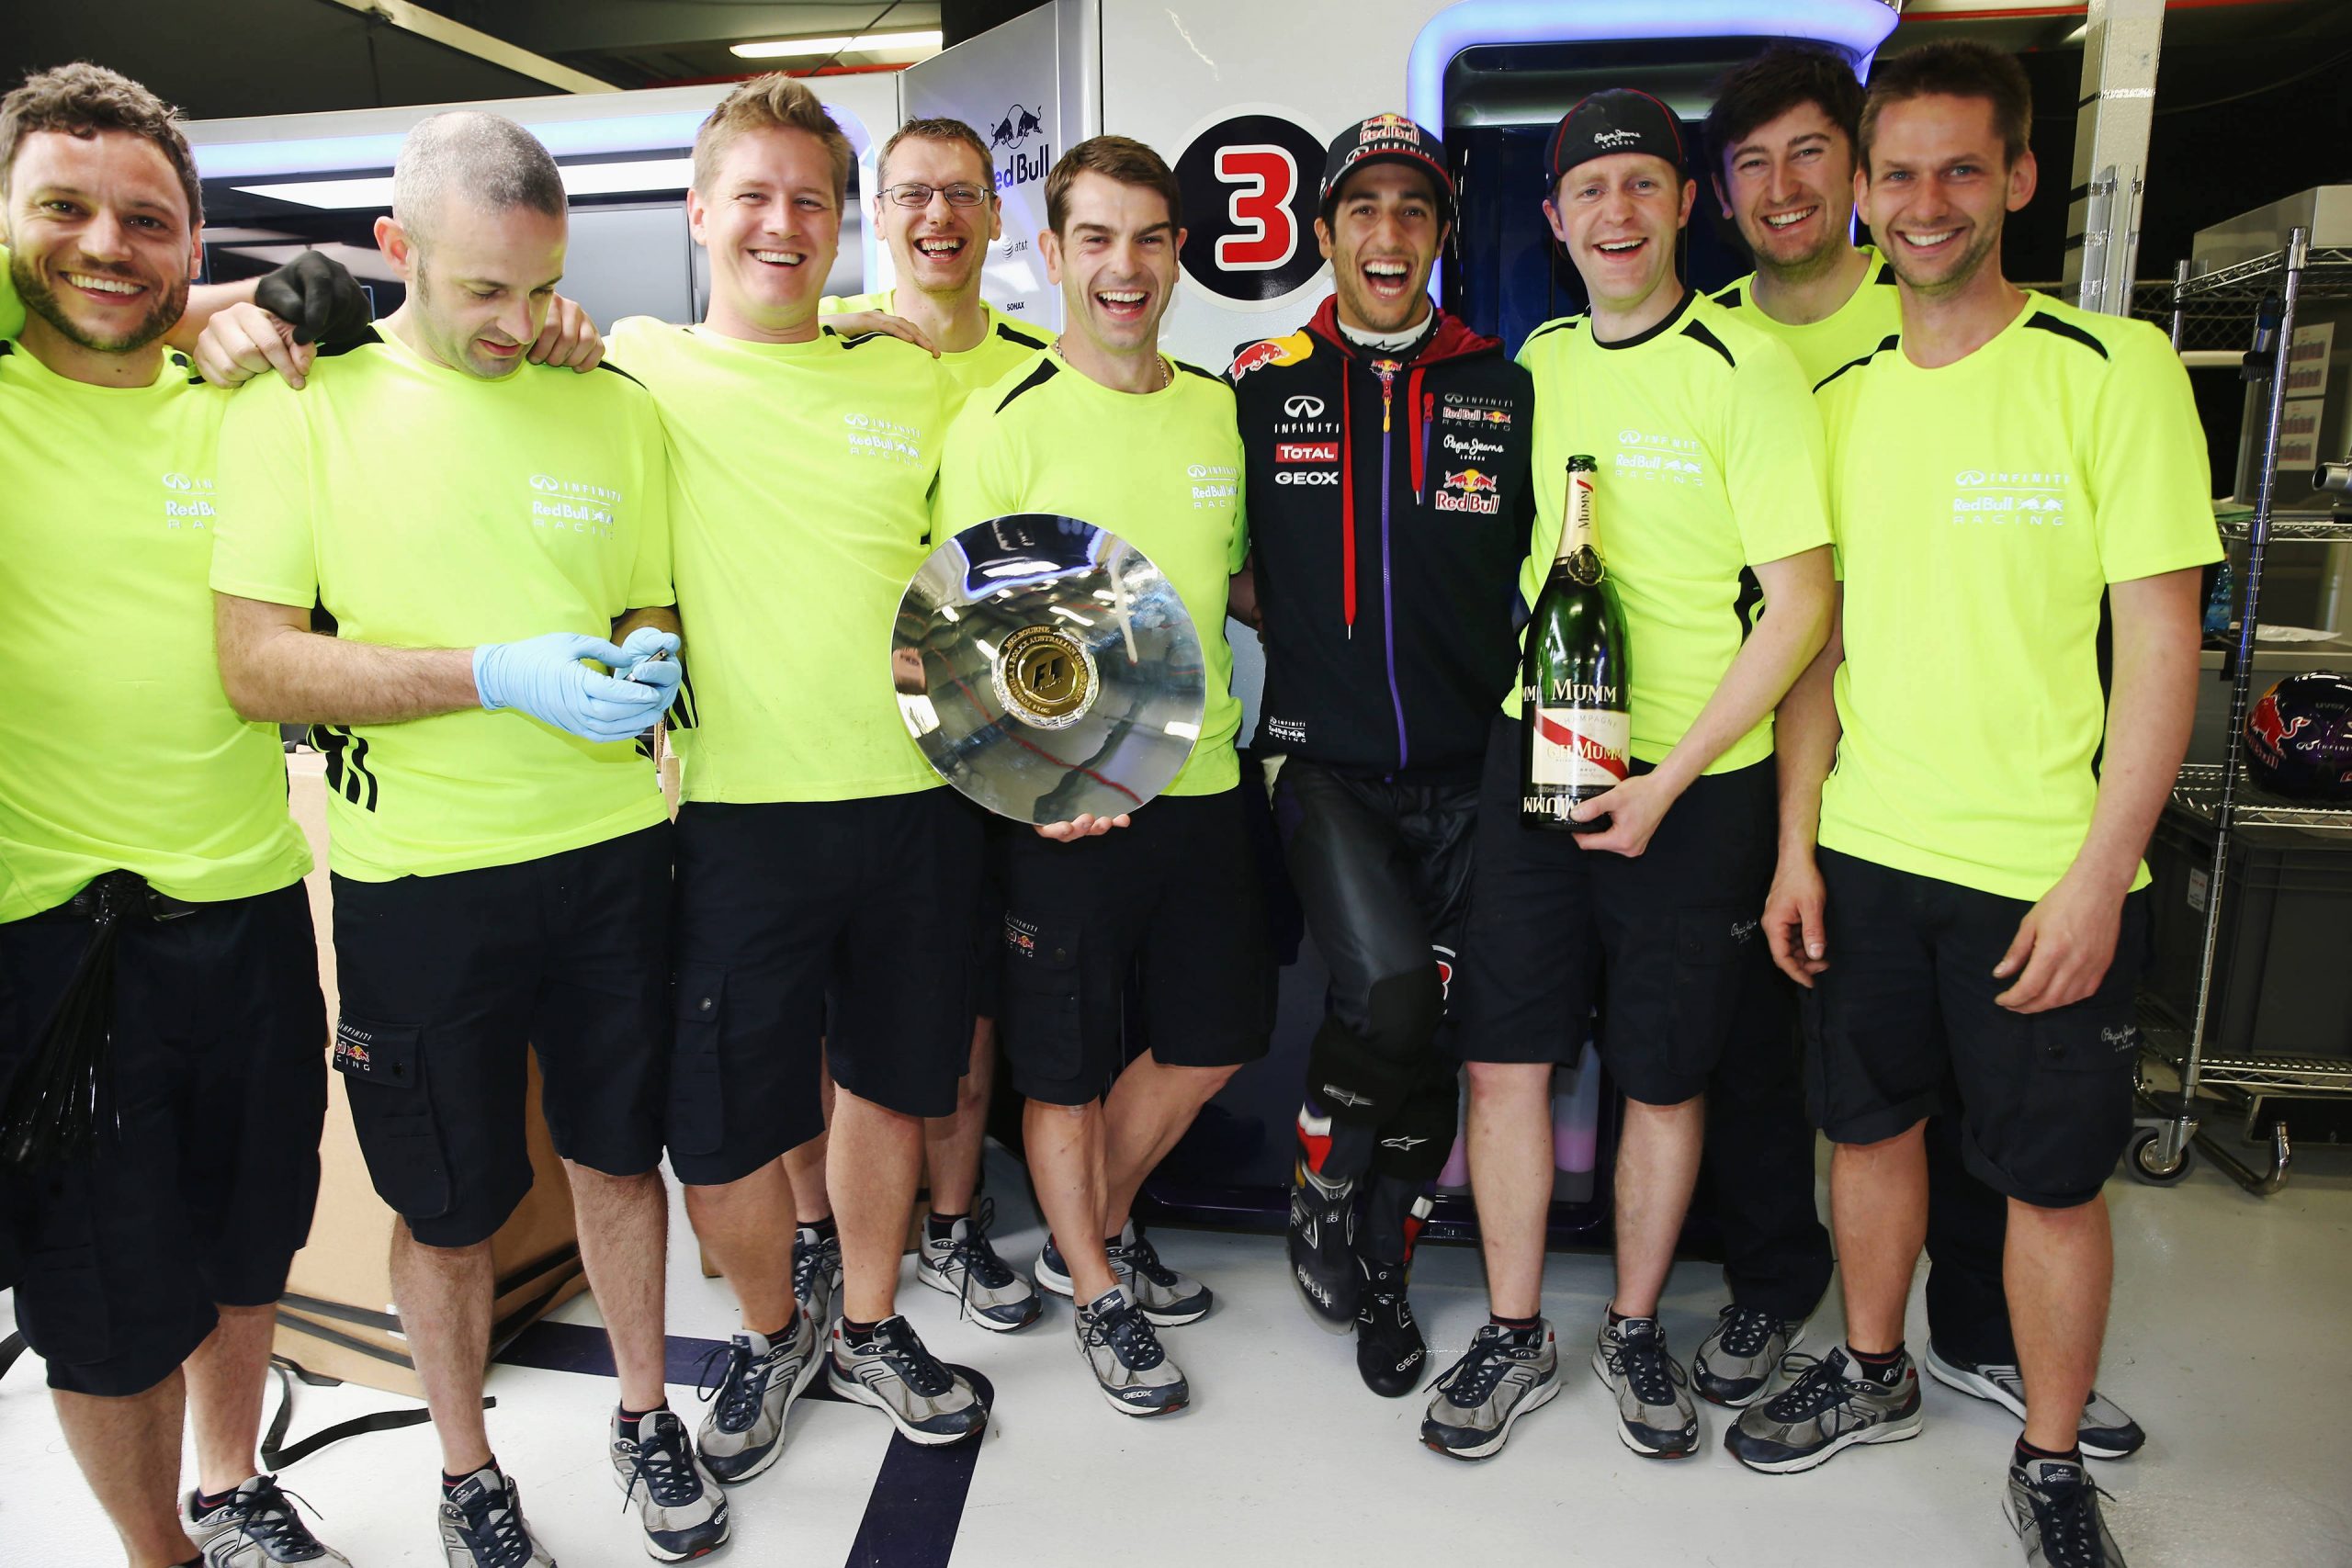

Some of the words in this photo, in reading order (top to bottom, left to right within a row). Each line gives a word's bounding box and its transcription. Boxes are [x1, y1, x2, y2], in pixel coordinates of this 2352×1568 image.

[1215, 144, 1298, 272] 3
[1014, 240, 1028, 253] at&t
[1006, 301, 1024, 311] SONAX
[1466, 396, 1512, 408] INFINITI
[1274, 423, 1340, 434] INFINITI
[1442, 419, 1510, 432] RACING
[1443, 434, 1470, 454] Pepe
[1469, 437, 1505, 455] Jeans
[1280, 445, 1335, 459] TOTAL
[1274, 471, 1340, 485] GEOX
[1990, 472, 2070, 485] INFINITI
[563, 481, 622, 502] INFINITI
[1953, 514, 2065, 526] RACING
[1004, 626, 1050, 650] MELBOURNE
[1030, 635, 1076, 655] AUSTRALIAN
[1551, 678, 1617, 704] MUMM
[339, 1023, 372, 1041] INFINITI
[1396, 1348, 1425, 1371] GEOX
[1123, 1390, 1153, 1400] GEOX
